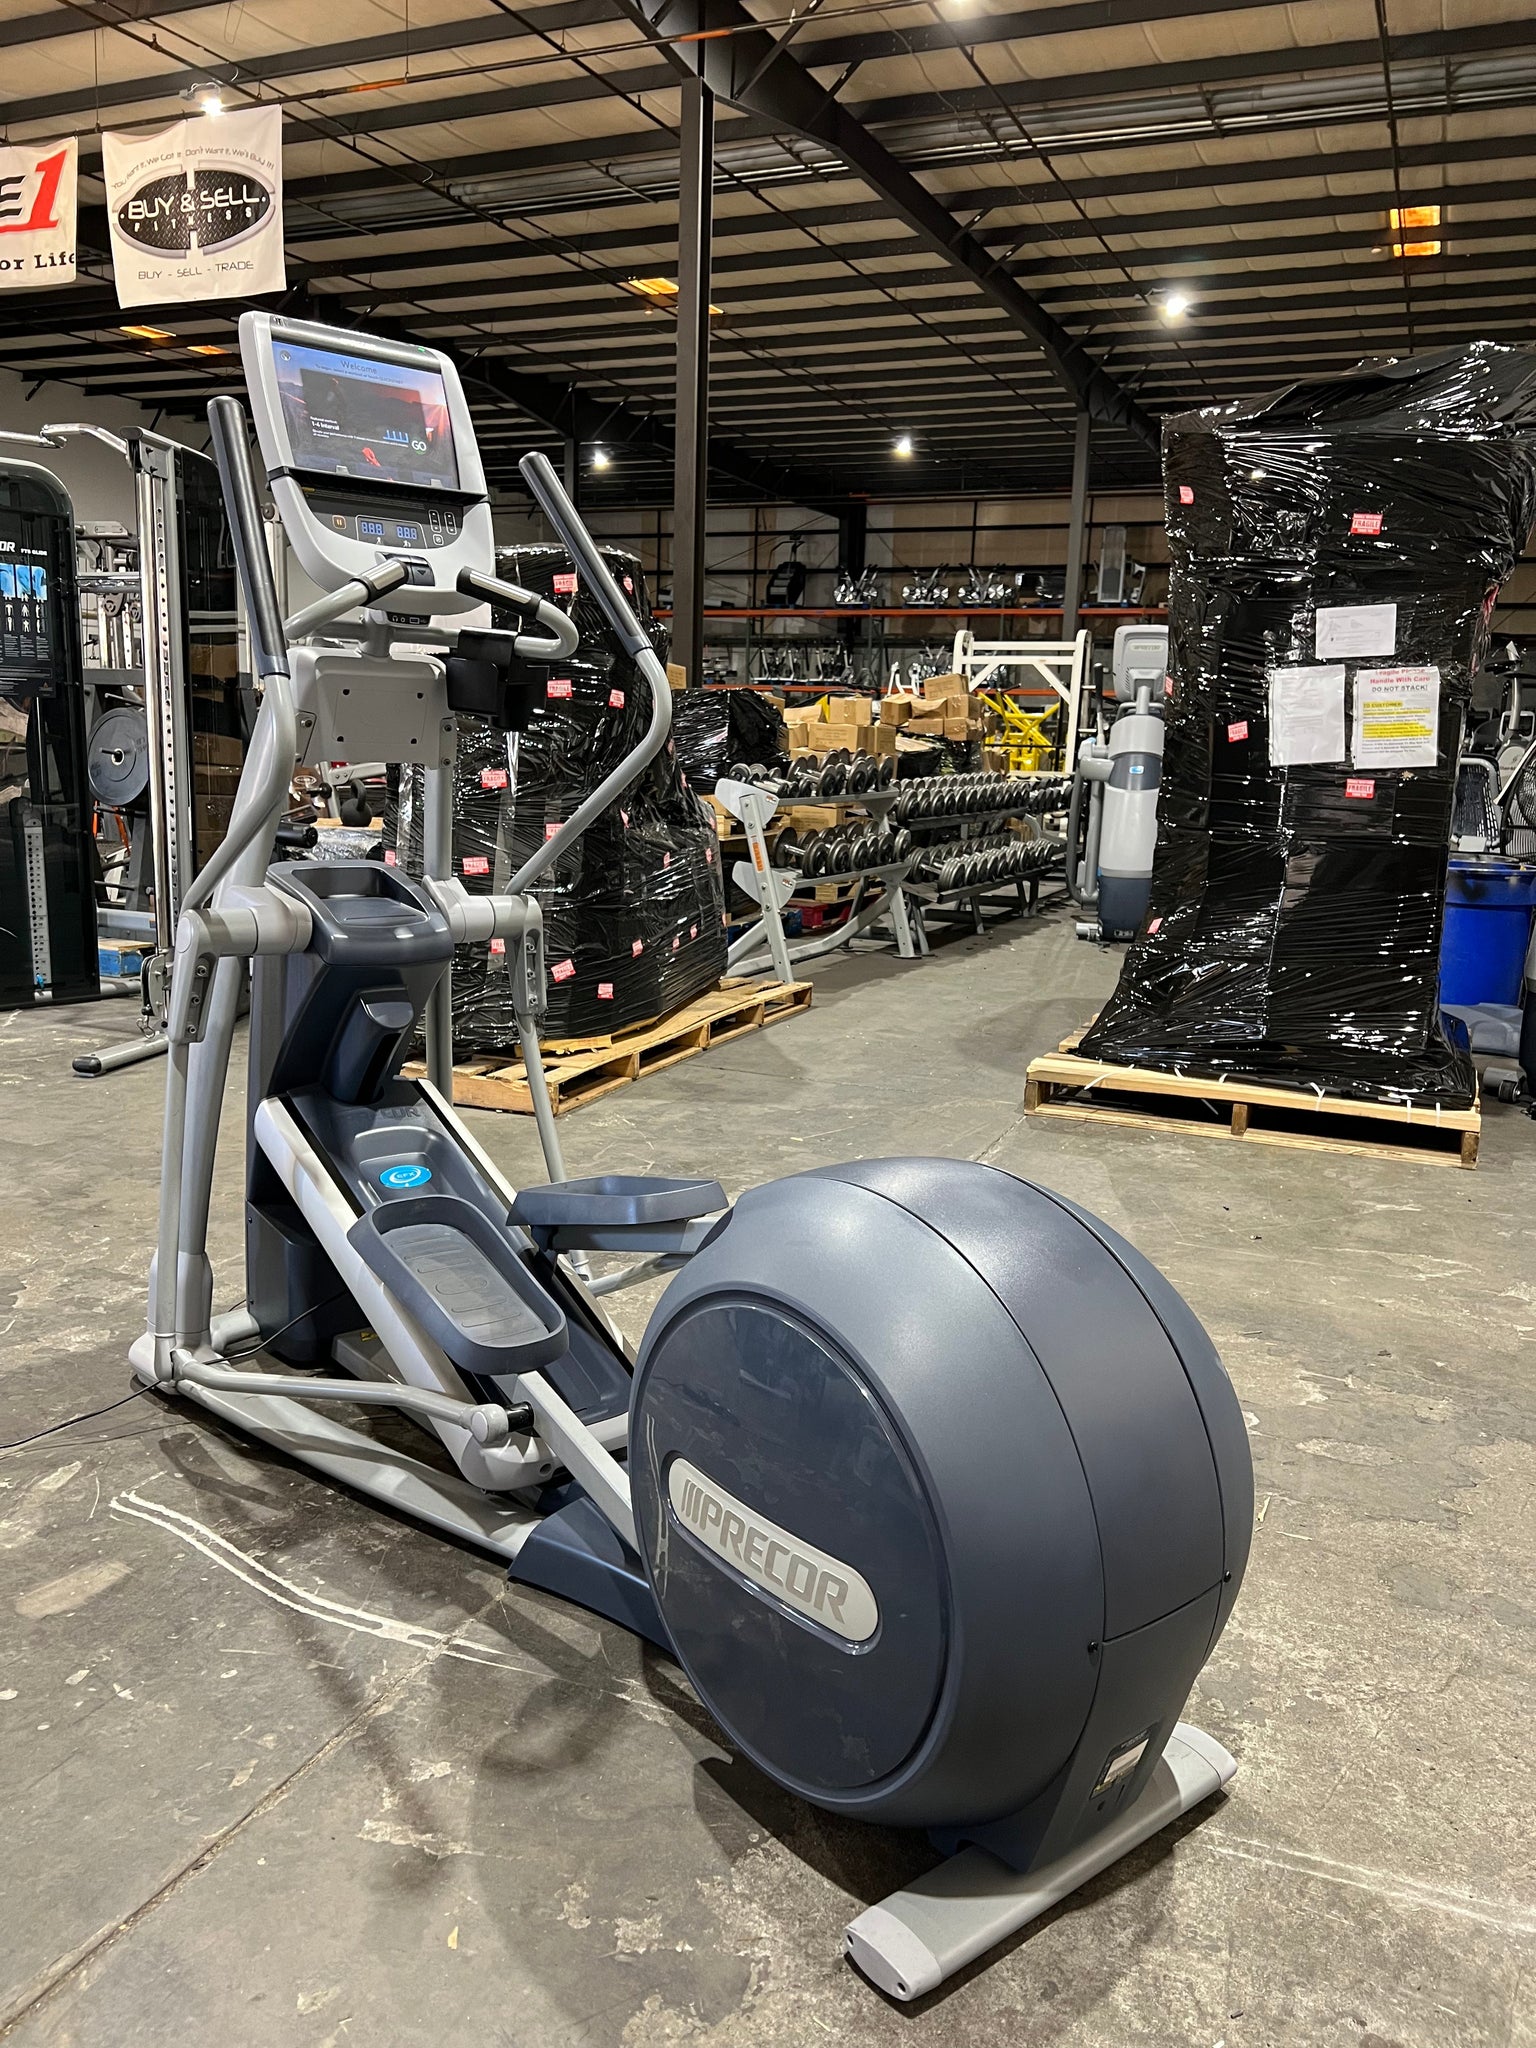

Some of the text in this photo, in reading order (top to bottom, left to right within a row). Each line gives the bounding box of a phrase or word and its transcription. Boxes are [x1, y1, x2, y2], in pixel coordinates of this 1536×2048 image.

[147, 157, 160, 166] We
[185, 146, 203, 157] Don't
[249, 153, 266, 166] Buy
[127, 184, 260, 220] BUY & SELL
[138, 270, 162, 280] BUY
[177, 266, 203, 278] SELL
[215, 260, 255, 272] TRADE
[340, 360, 378, 375] Welcome
[411, 440, 427, 451] GO
[1401, 684, 1428, 692] STACK!
[699, 1493, 849, 1625] PRECOR
